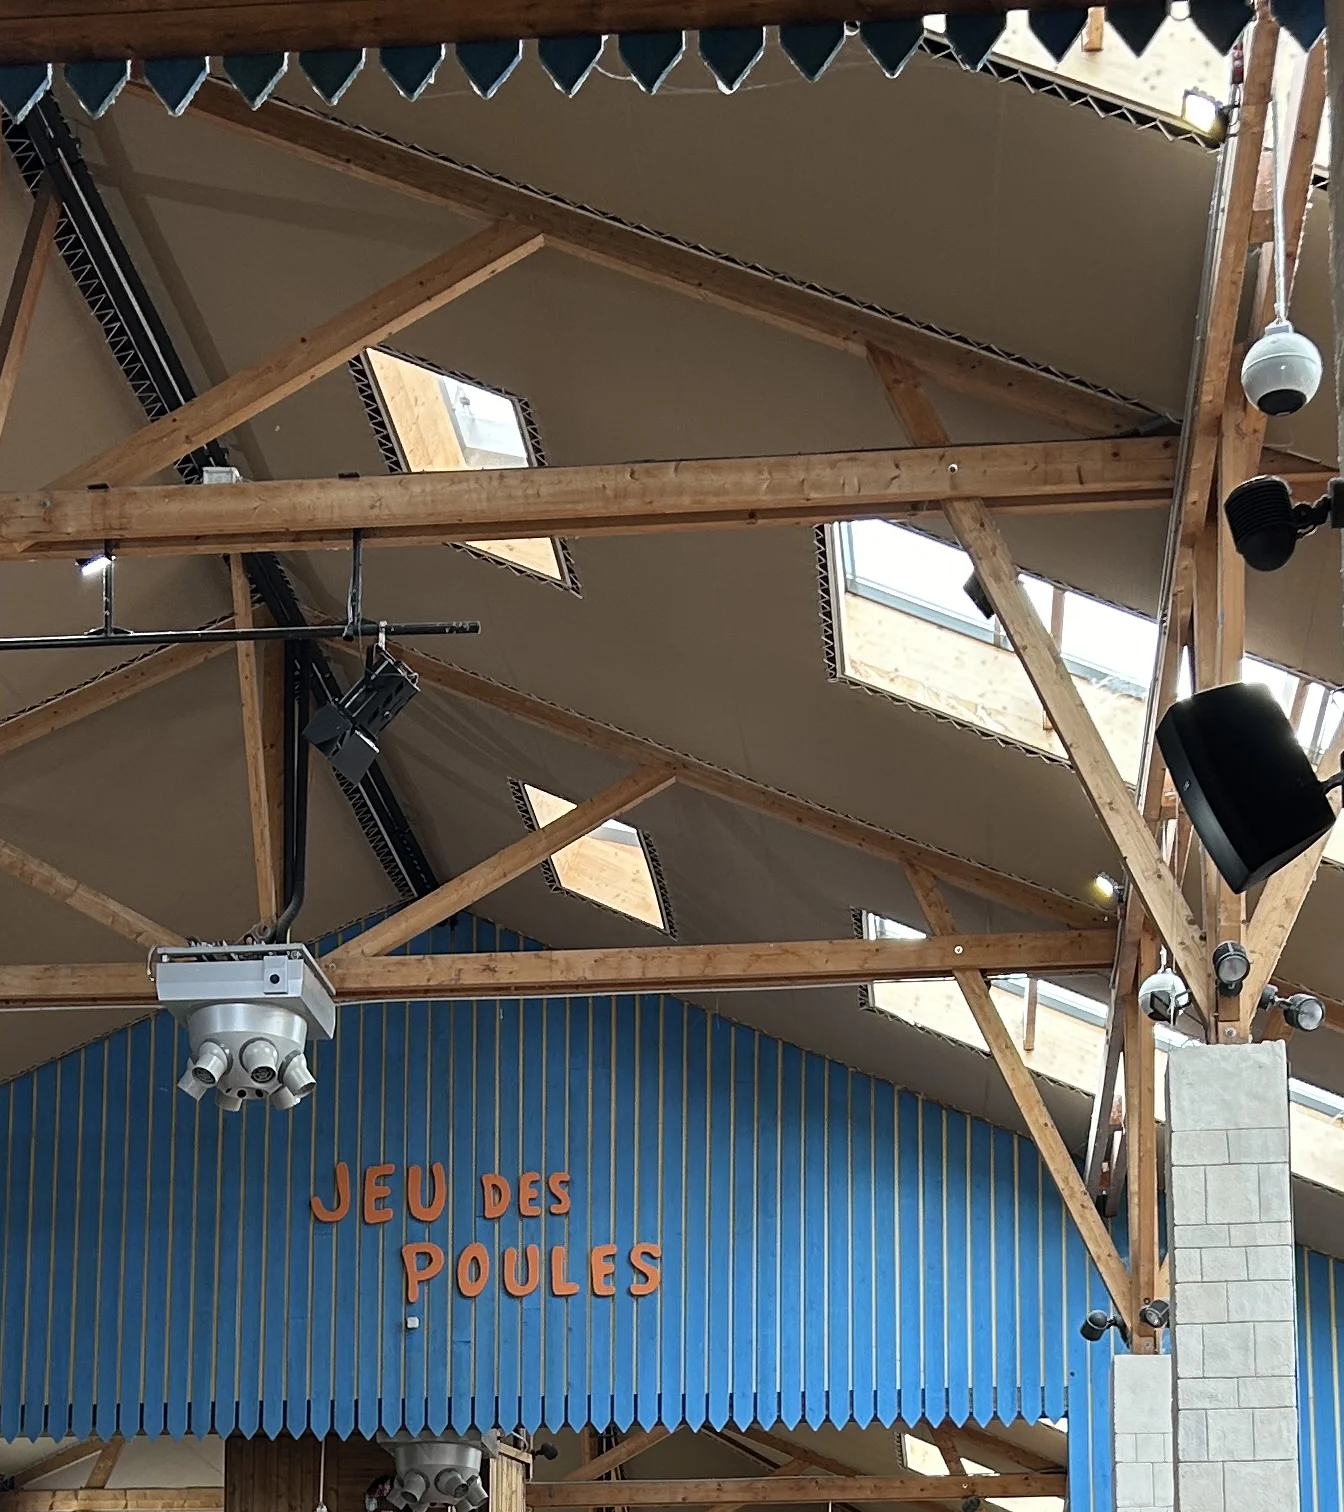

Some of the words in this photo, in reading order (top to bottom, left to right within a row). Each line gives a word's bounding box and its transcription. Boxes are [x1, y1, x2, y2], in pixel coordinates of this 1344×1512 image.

[311, 1161, 447, 1224] JEU
[481, 1172, 571, 1220] DES
[401, 1242, 662, 1303] POULES
